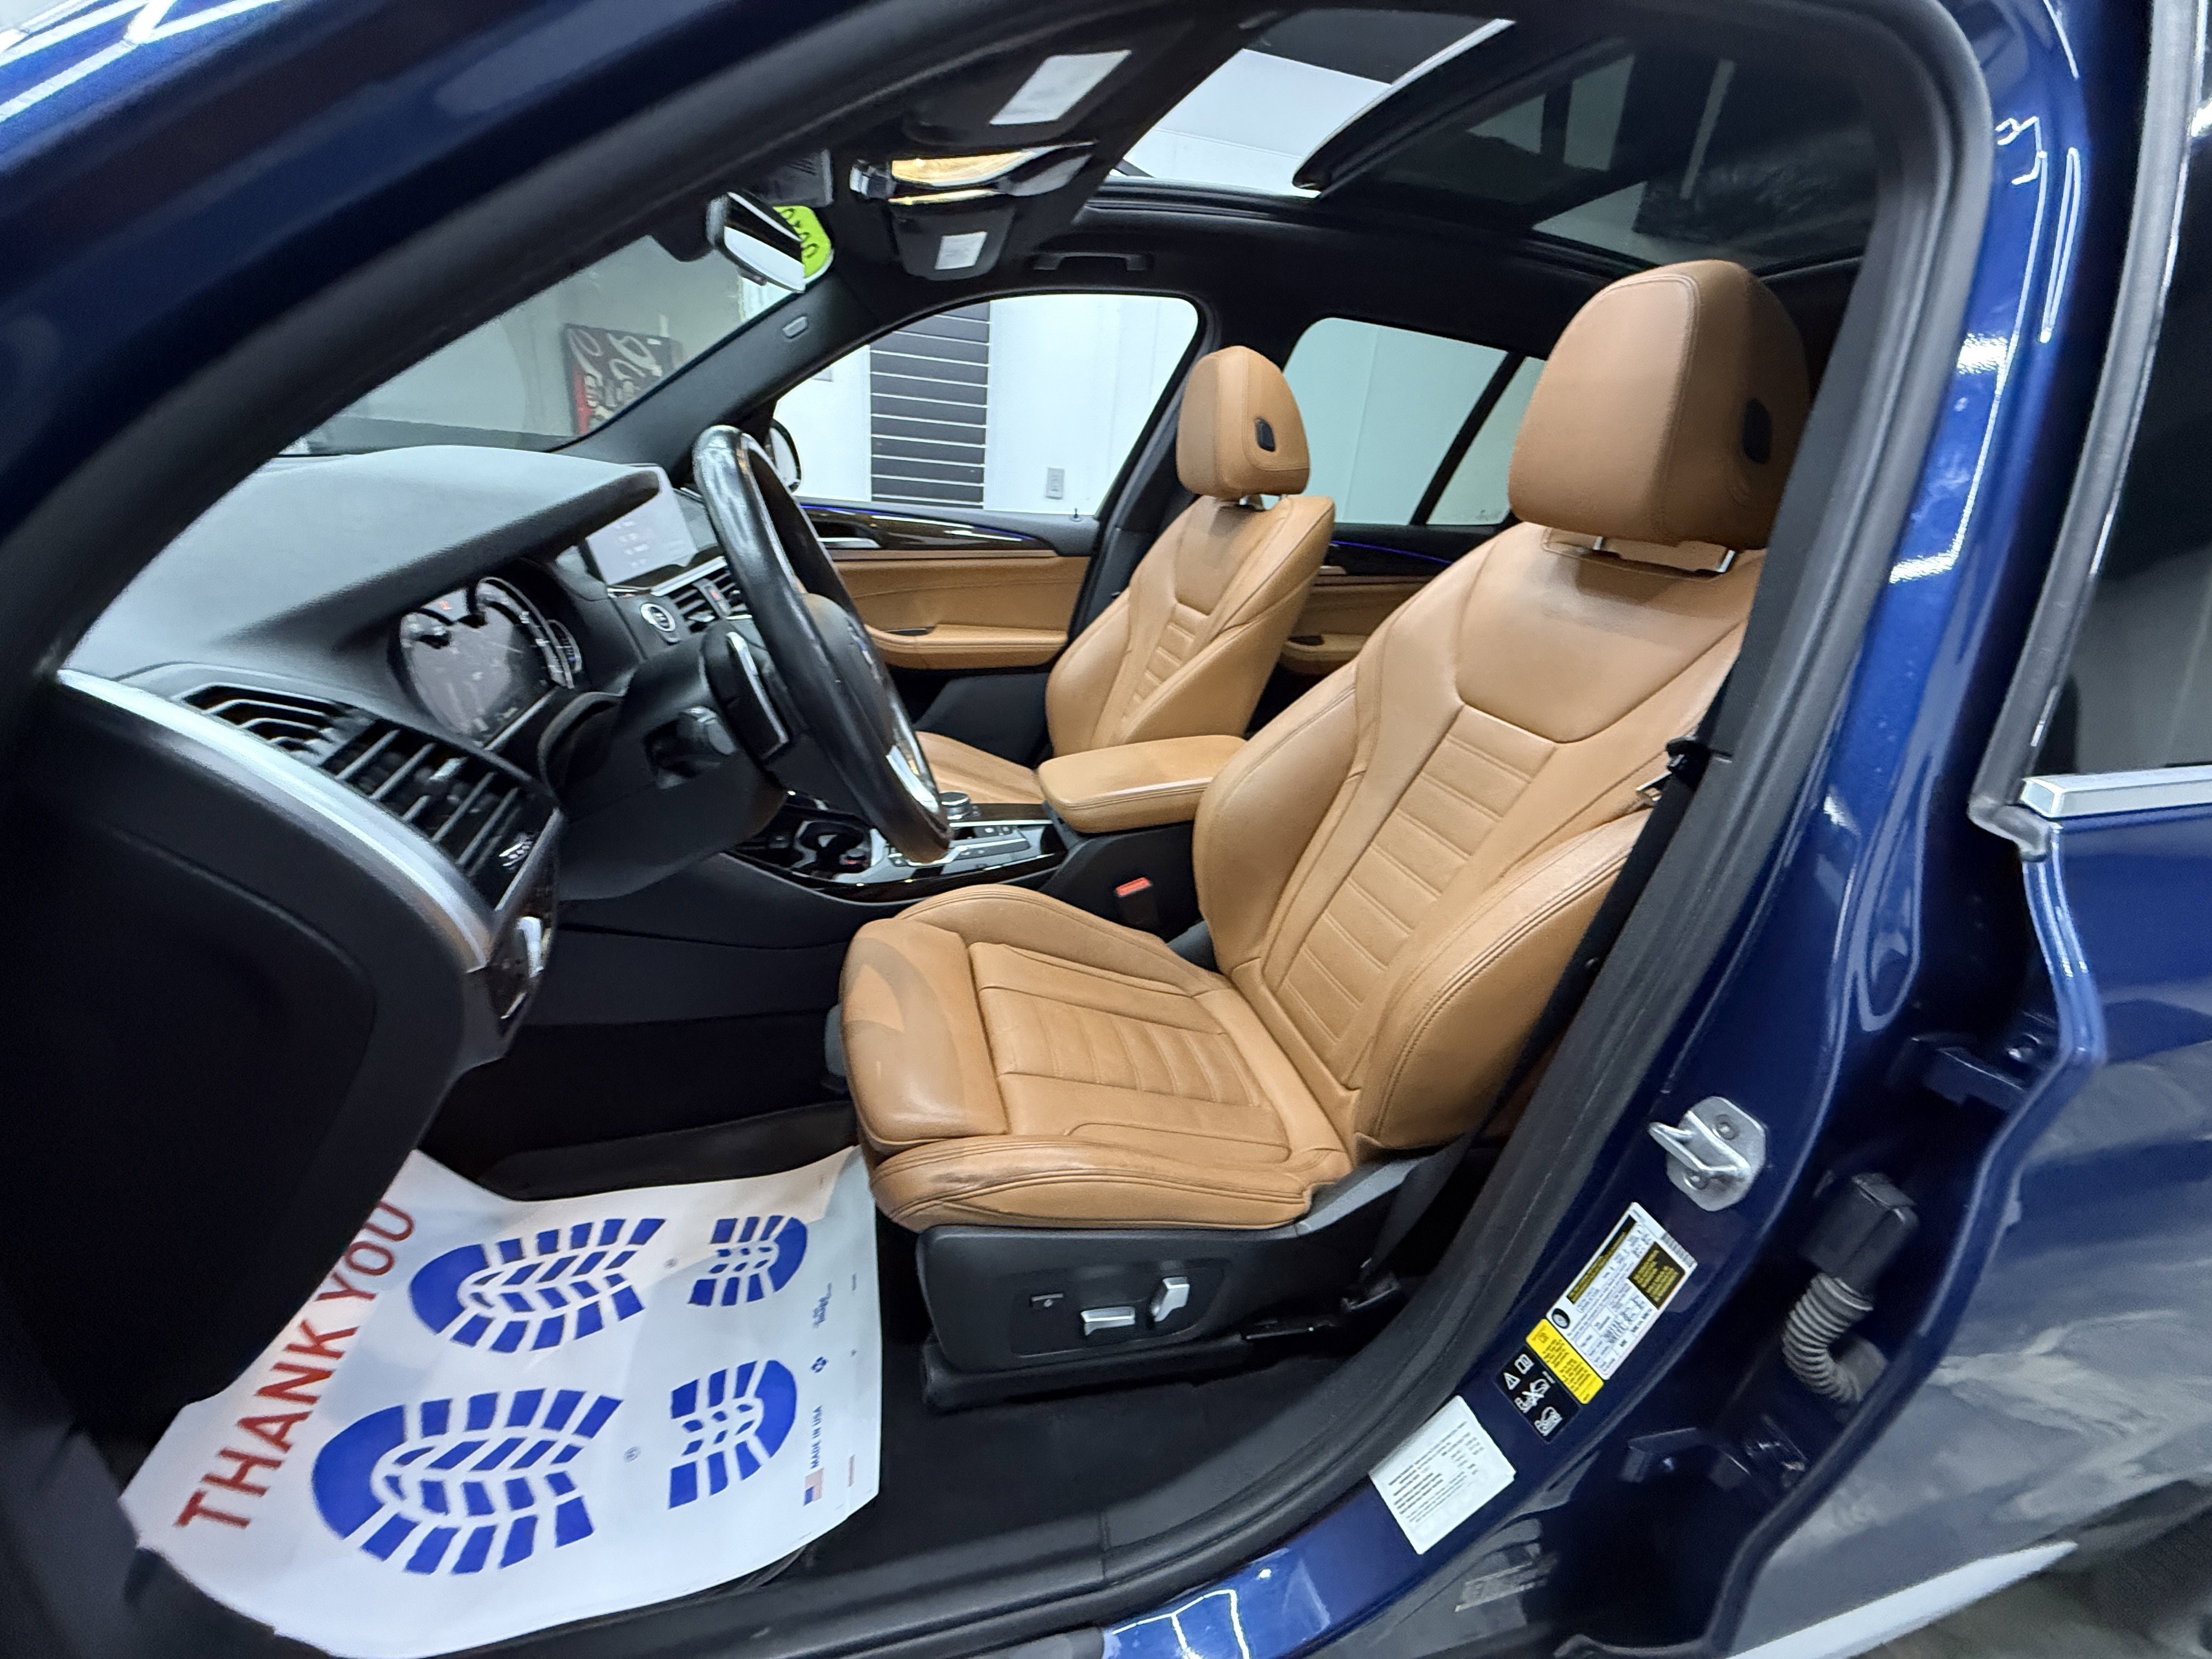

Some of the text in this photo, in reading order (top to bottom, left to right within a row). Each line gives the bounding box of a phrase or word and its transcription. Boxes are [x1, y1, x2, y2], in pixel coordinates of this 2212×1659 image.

[173, 1200, 415, 1528] THANK YOU
[810, 1405, 822, 1469] MADE IN USA
